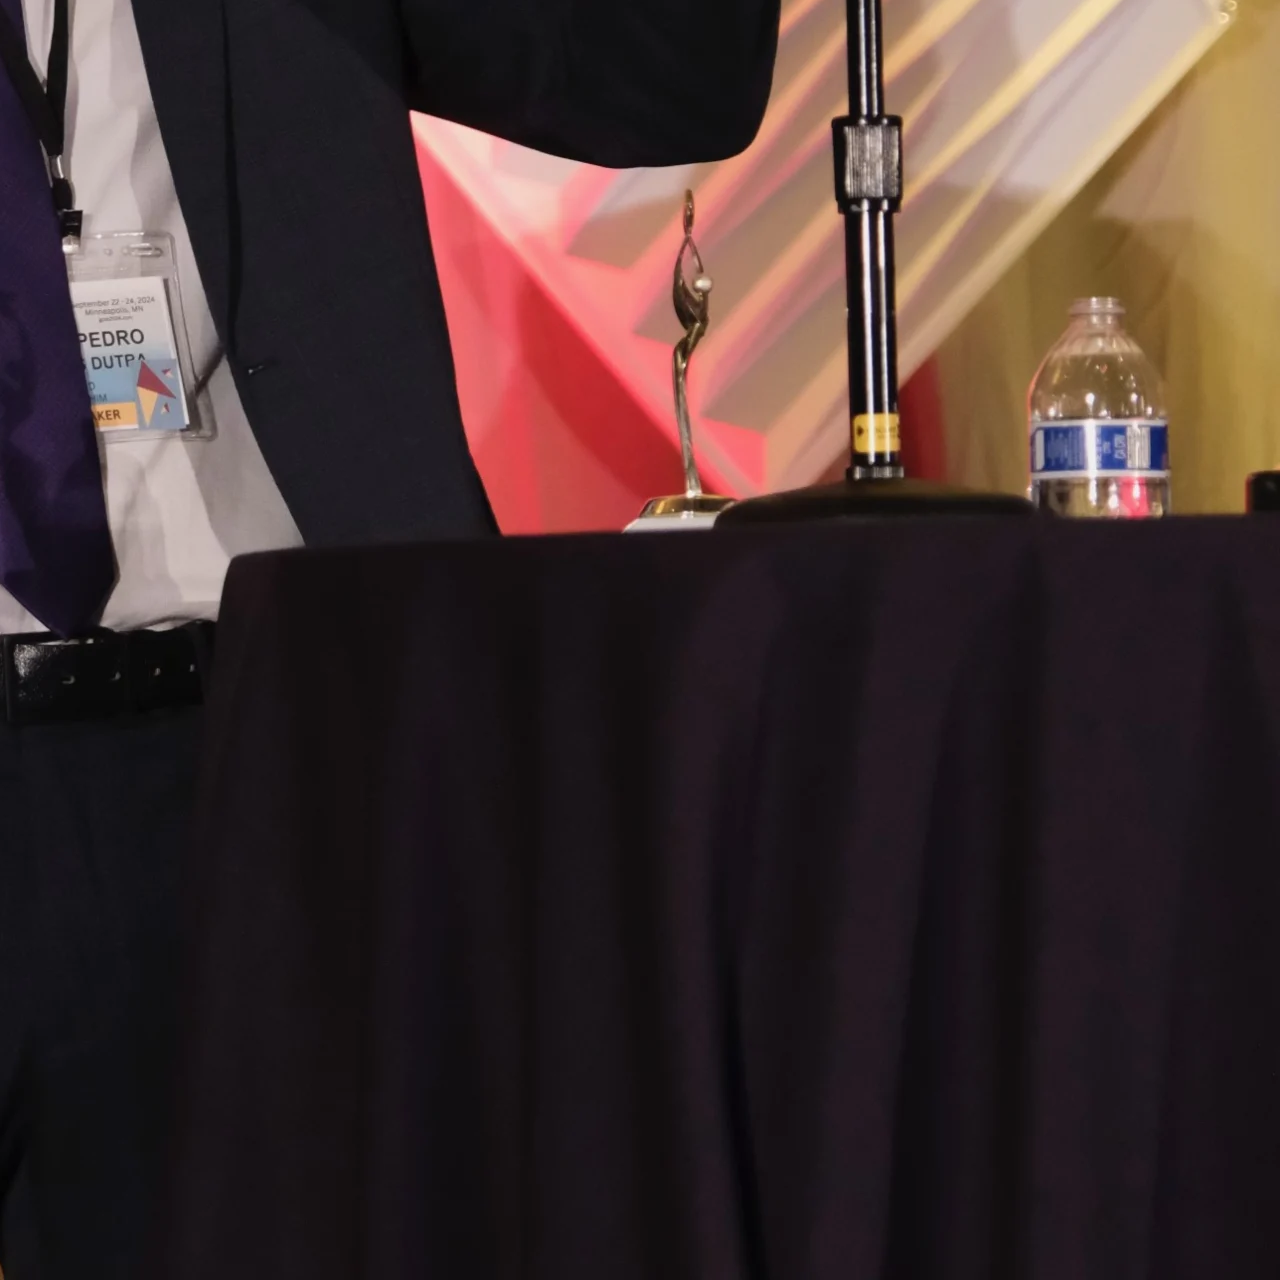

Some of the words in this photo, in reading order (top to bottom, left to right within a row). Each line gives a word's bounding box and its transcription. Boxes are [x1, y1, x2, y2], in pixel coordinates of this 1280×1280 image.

[73, 300, 110, 309] eptember
[110, 298, 120, 306] 22
[137, 296, 155, 304] 2024
[131, 305, 144, 313] MN
[78, 329, 144, 348] PEDRO
